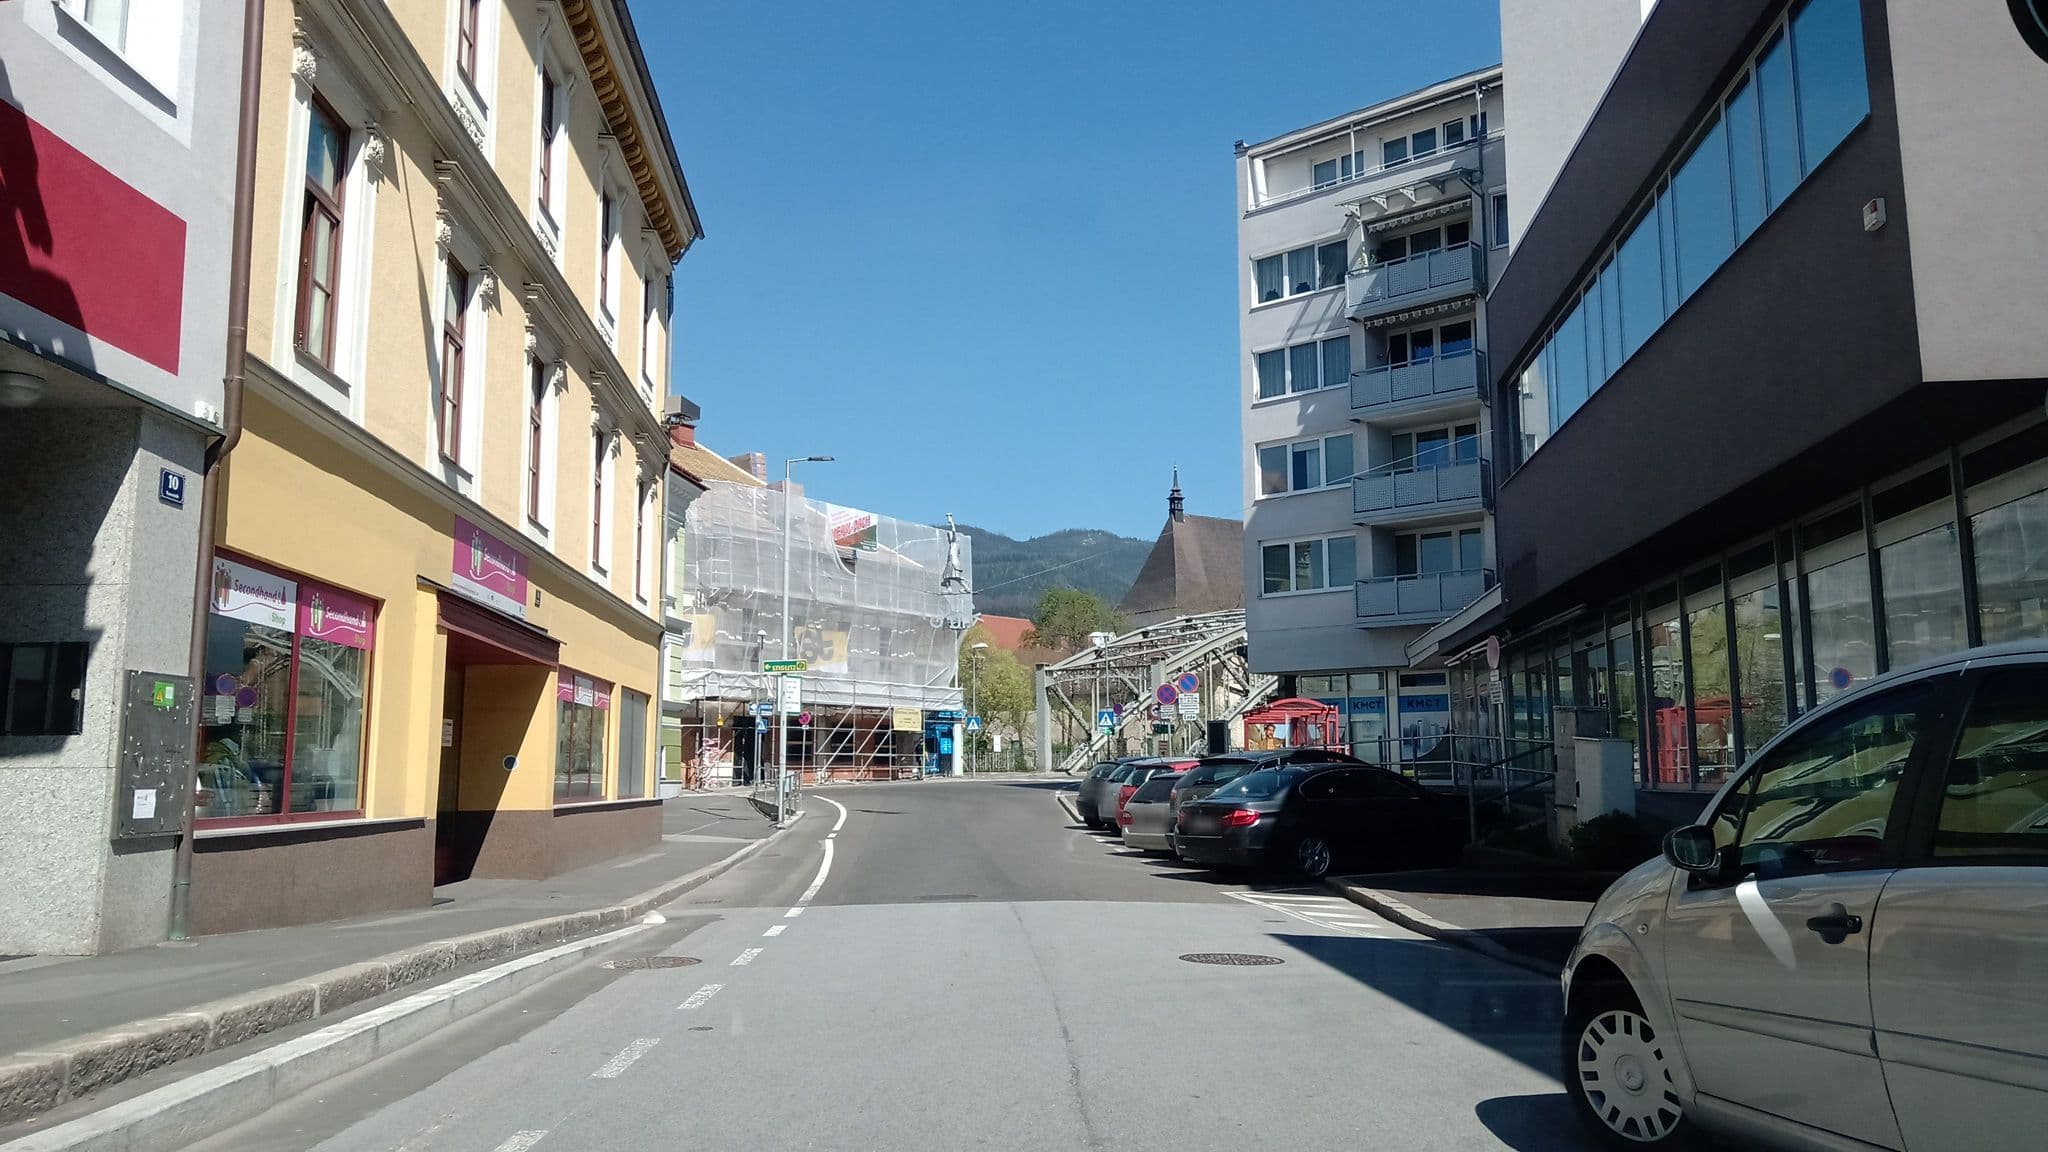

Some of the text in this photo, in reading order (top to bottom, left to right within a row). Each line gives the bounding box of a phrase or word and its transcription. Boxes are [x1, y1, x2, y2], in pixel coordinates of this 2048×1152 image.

[168, 474, 179, 490] 10
[234, 579, 277, 604] Secondhand
[271, 612, 286, 627] Shop
[325, 606, 359, 627] Secondhand
[1353, 700, 1382, 710] KMCT
[1407, 700, 1440, 709] KMCT
